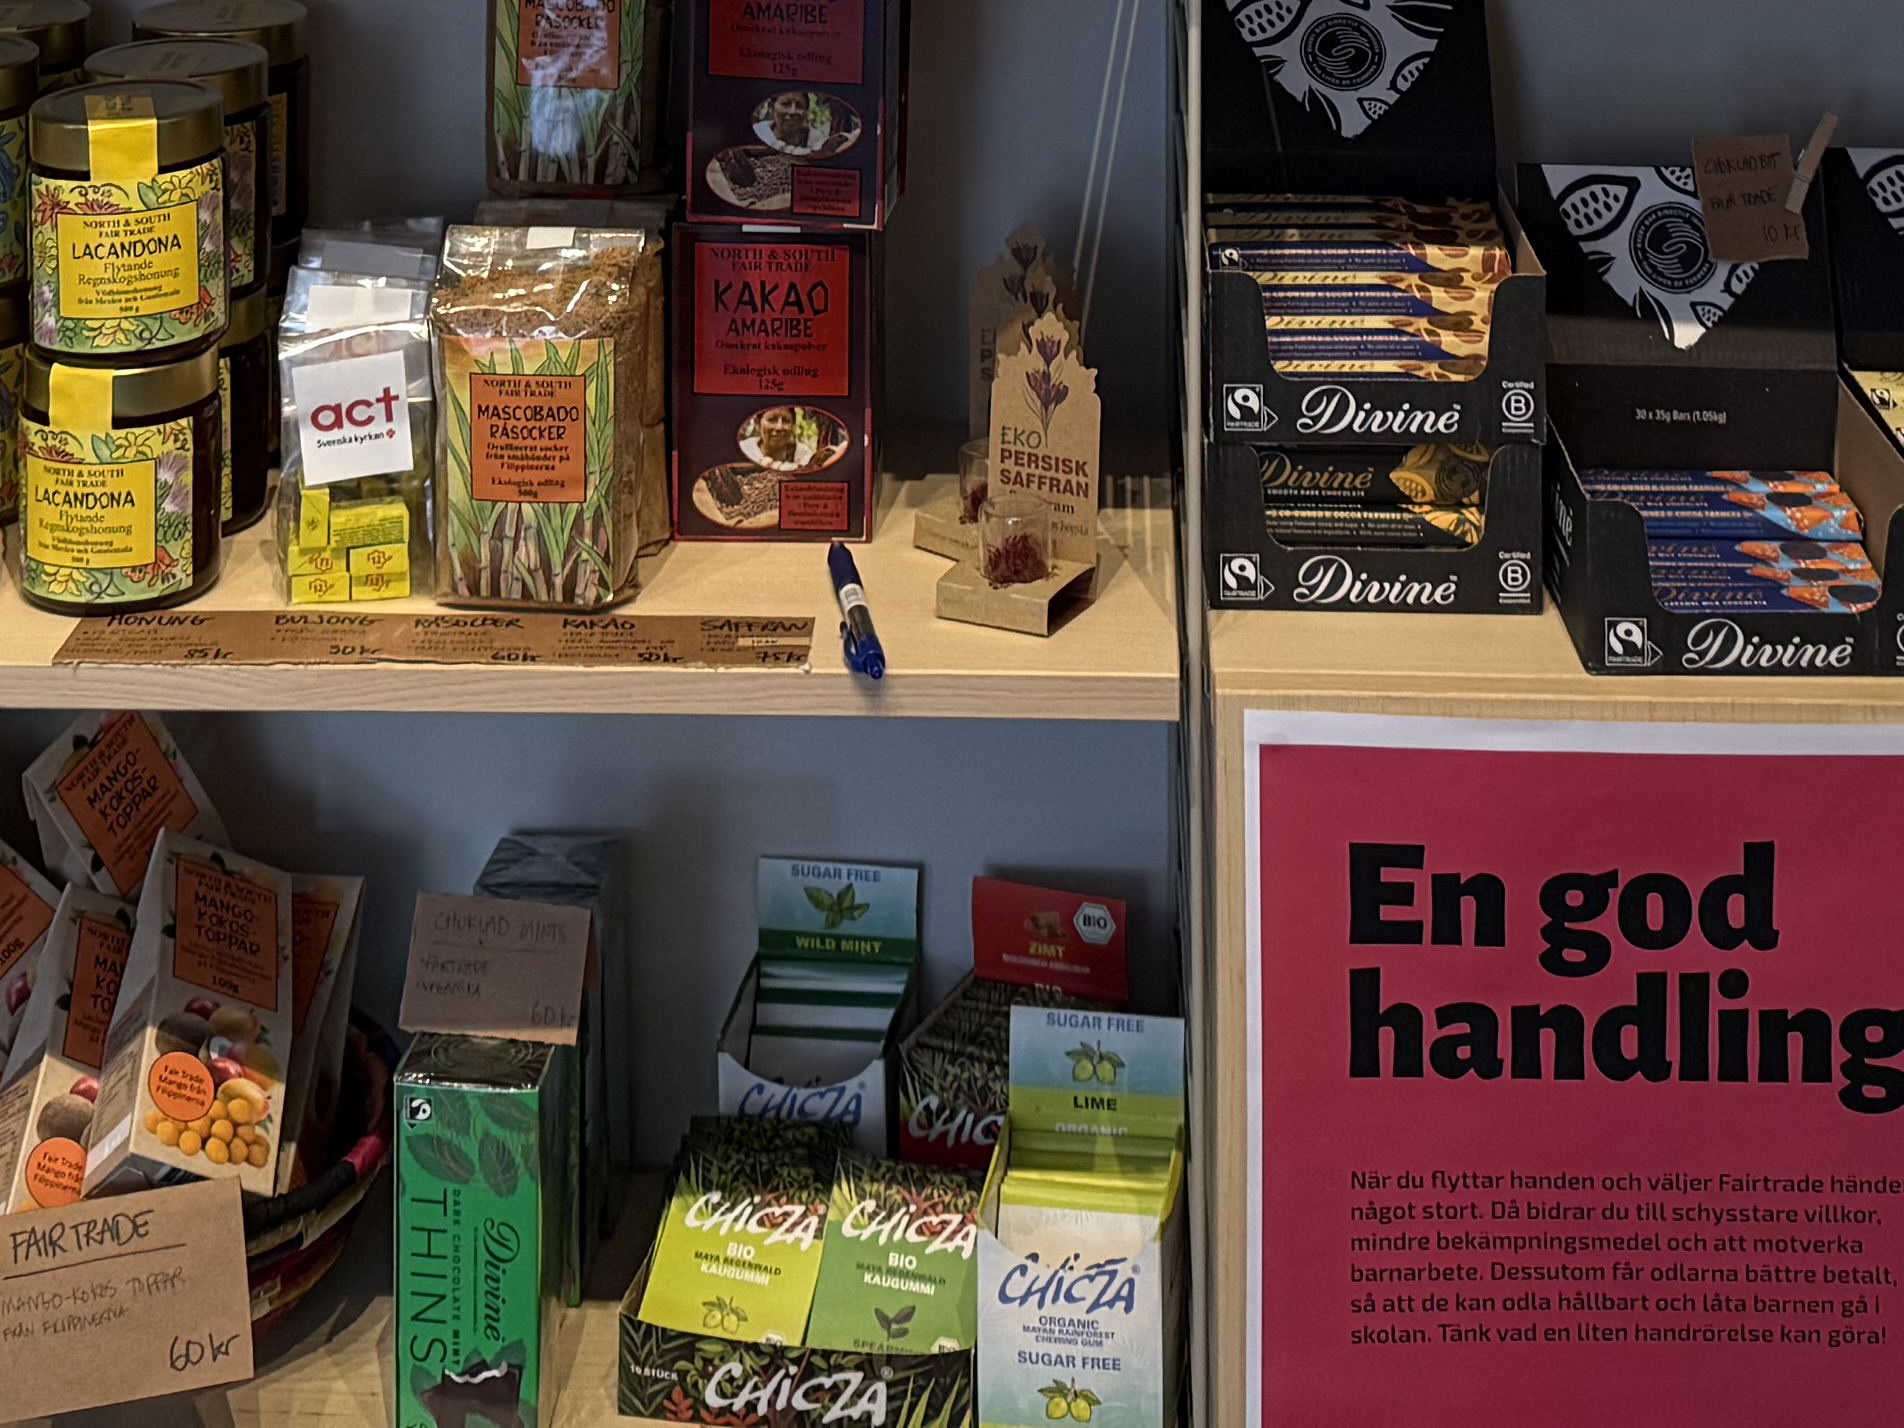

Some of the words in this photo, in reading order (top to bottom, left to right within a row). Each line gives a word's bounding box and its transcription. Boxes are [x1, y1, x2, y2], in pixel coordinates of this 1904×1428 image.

[712, 278, 831, 317] KAKAO
[727, 314, 815, 340] AMARIBE
[310, 386, 401, 433] act
[476, 403, 580, 426] MASCOBADO
[489, 418, 568, 442] RÅSOCKER
[999, 426, 1043, 451] EKO
[999, 448, 1091, 479] PERSISK
[999, 468, 1091, 499] SAFFRAN
[789, 862, 841, 881] SUGAR
[846, 865, 883, 884] FREE
[1346, 840, 1508, 949] En
[1537, 839, 1782, 980] god
[1071, 1093, 1120, 1113] LIME
[1350, 1171, 1391, 1192] När
[1396, 1171, 1425, 1191] du
[1431, 1169, 1504, 1192] flyttar
[1509, 1171, 1596, 1192] handen
[1719, 1173, 1825, 1194] Fairtrade
[9, 1226, 66, 1266] FAIR
[65, 1208, 156, 1249] TRADE
[407, 1187, 449, 1368] THINS
[1037, 1315, 1101, 1331] ORGANIC
[169, 1339, 207, 1373] 60
[209, 1331, 242, 1363] kr
